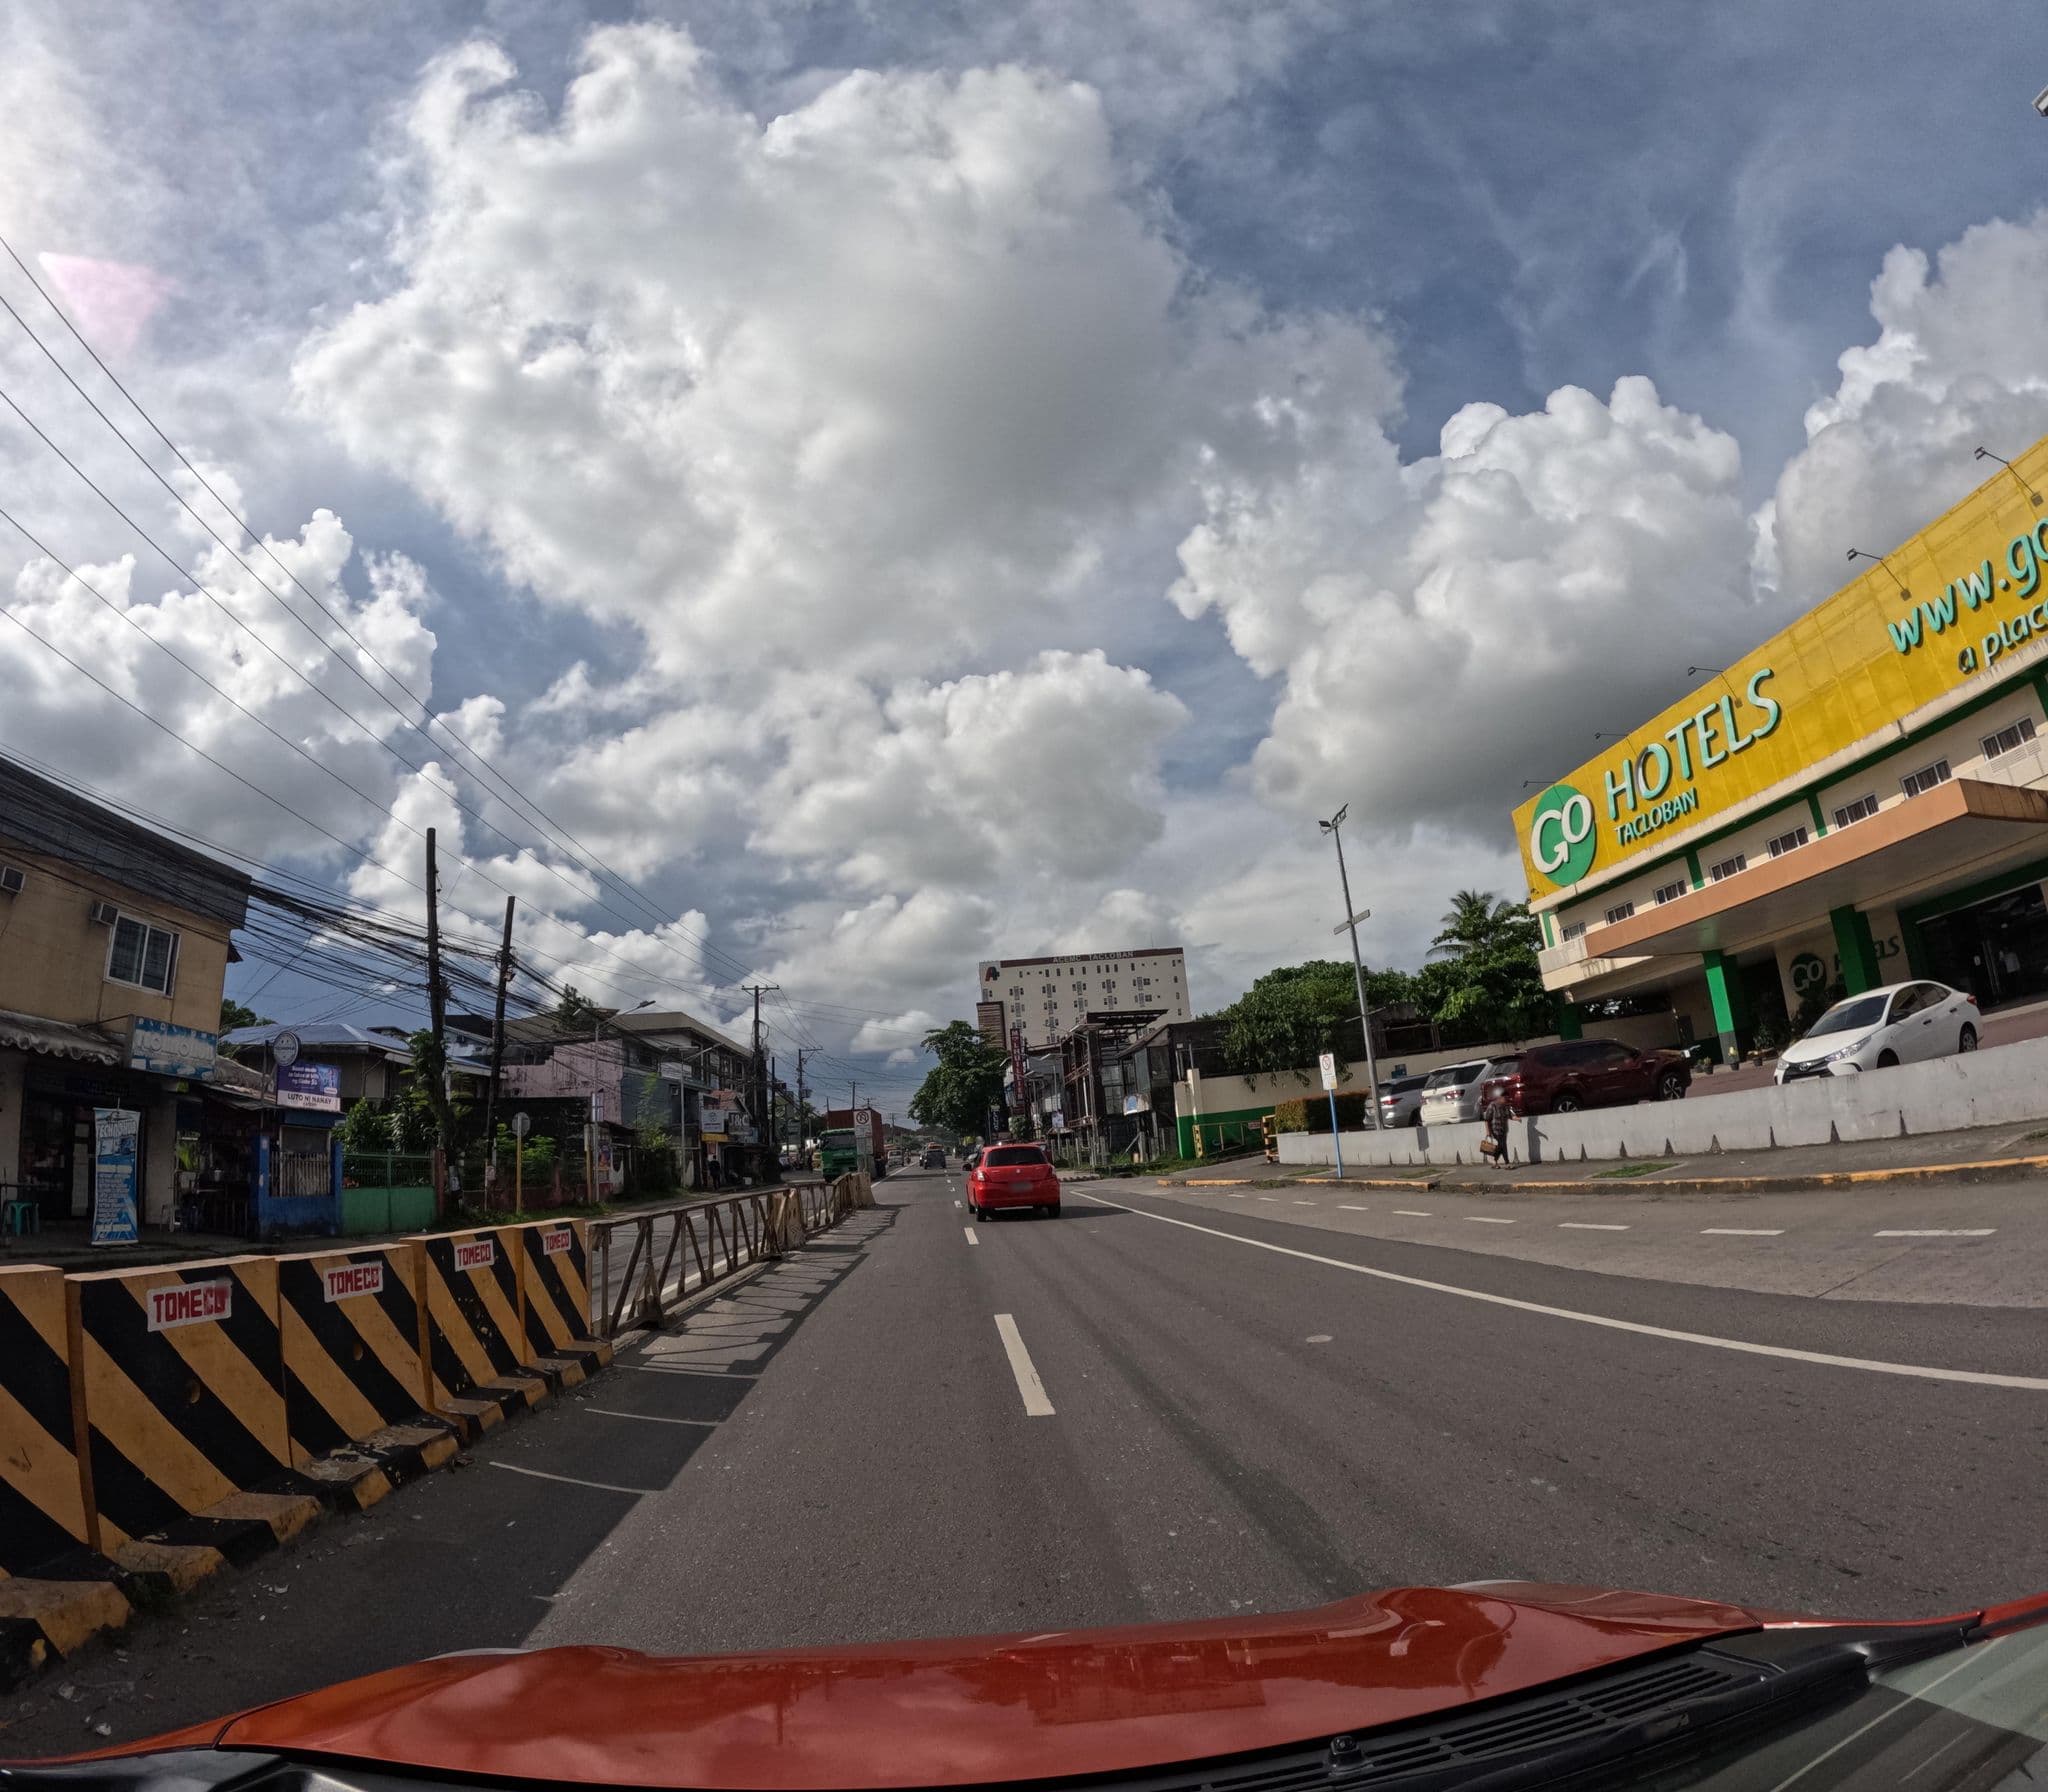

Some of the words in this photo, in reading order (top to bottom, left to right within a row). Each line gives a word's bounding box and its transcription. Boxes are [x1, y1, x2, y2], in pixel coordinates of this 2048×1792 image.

[1958, 646, 1976, 673] a
[1531, 794, 1593, 874] GO
[1605, 667, 1781, 821] HOTELS
[1613, 787, 1698, 846] TACLOBAN
[1053, 953, 1081, 964] ACEMC
[1088, 950, 1134, 961] TACLOBAN
[288, 1093, 303, 1102] LUTO
[305, 1095, 311, 1103] NI
[545, 1232, 569, 1251] TOMECO
[457, 1243, 491, 1267] TOMECO
[328, 1266, 380, 1297] TOMECO
